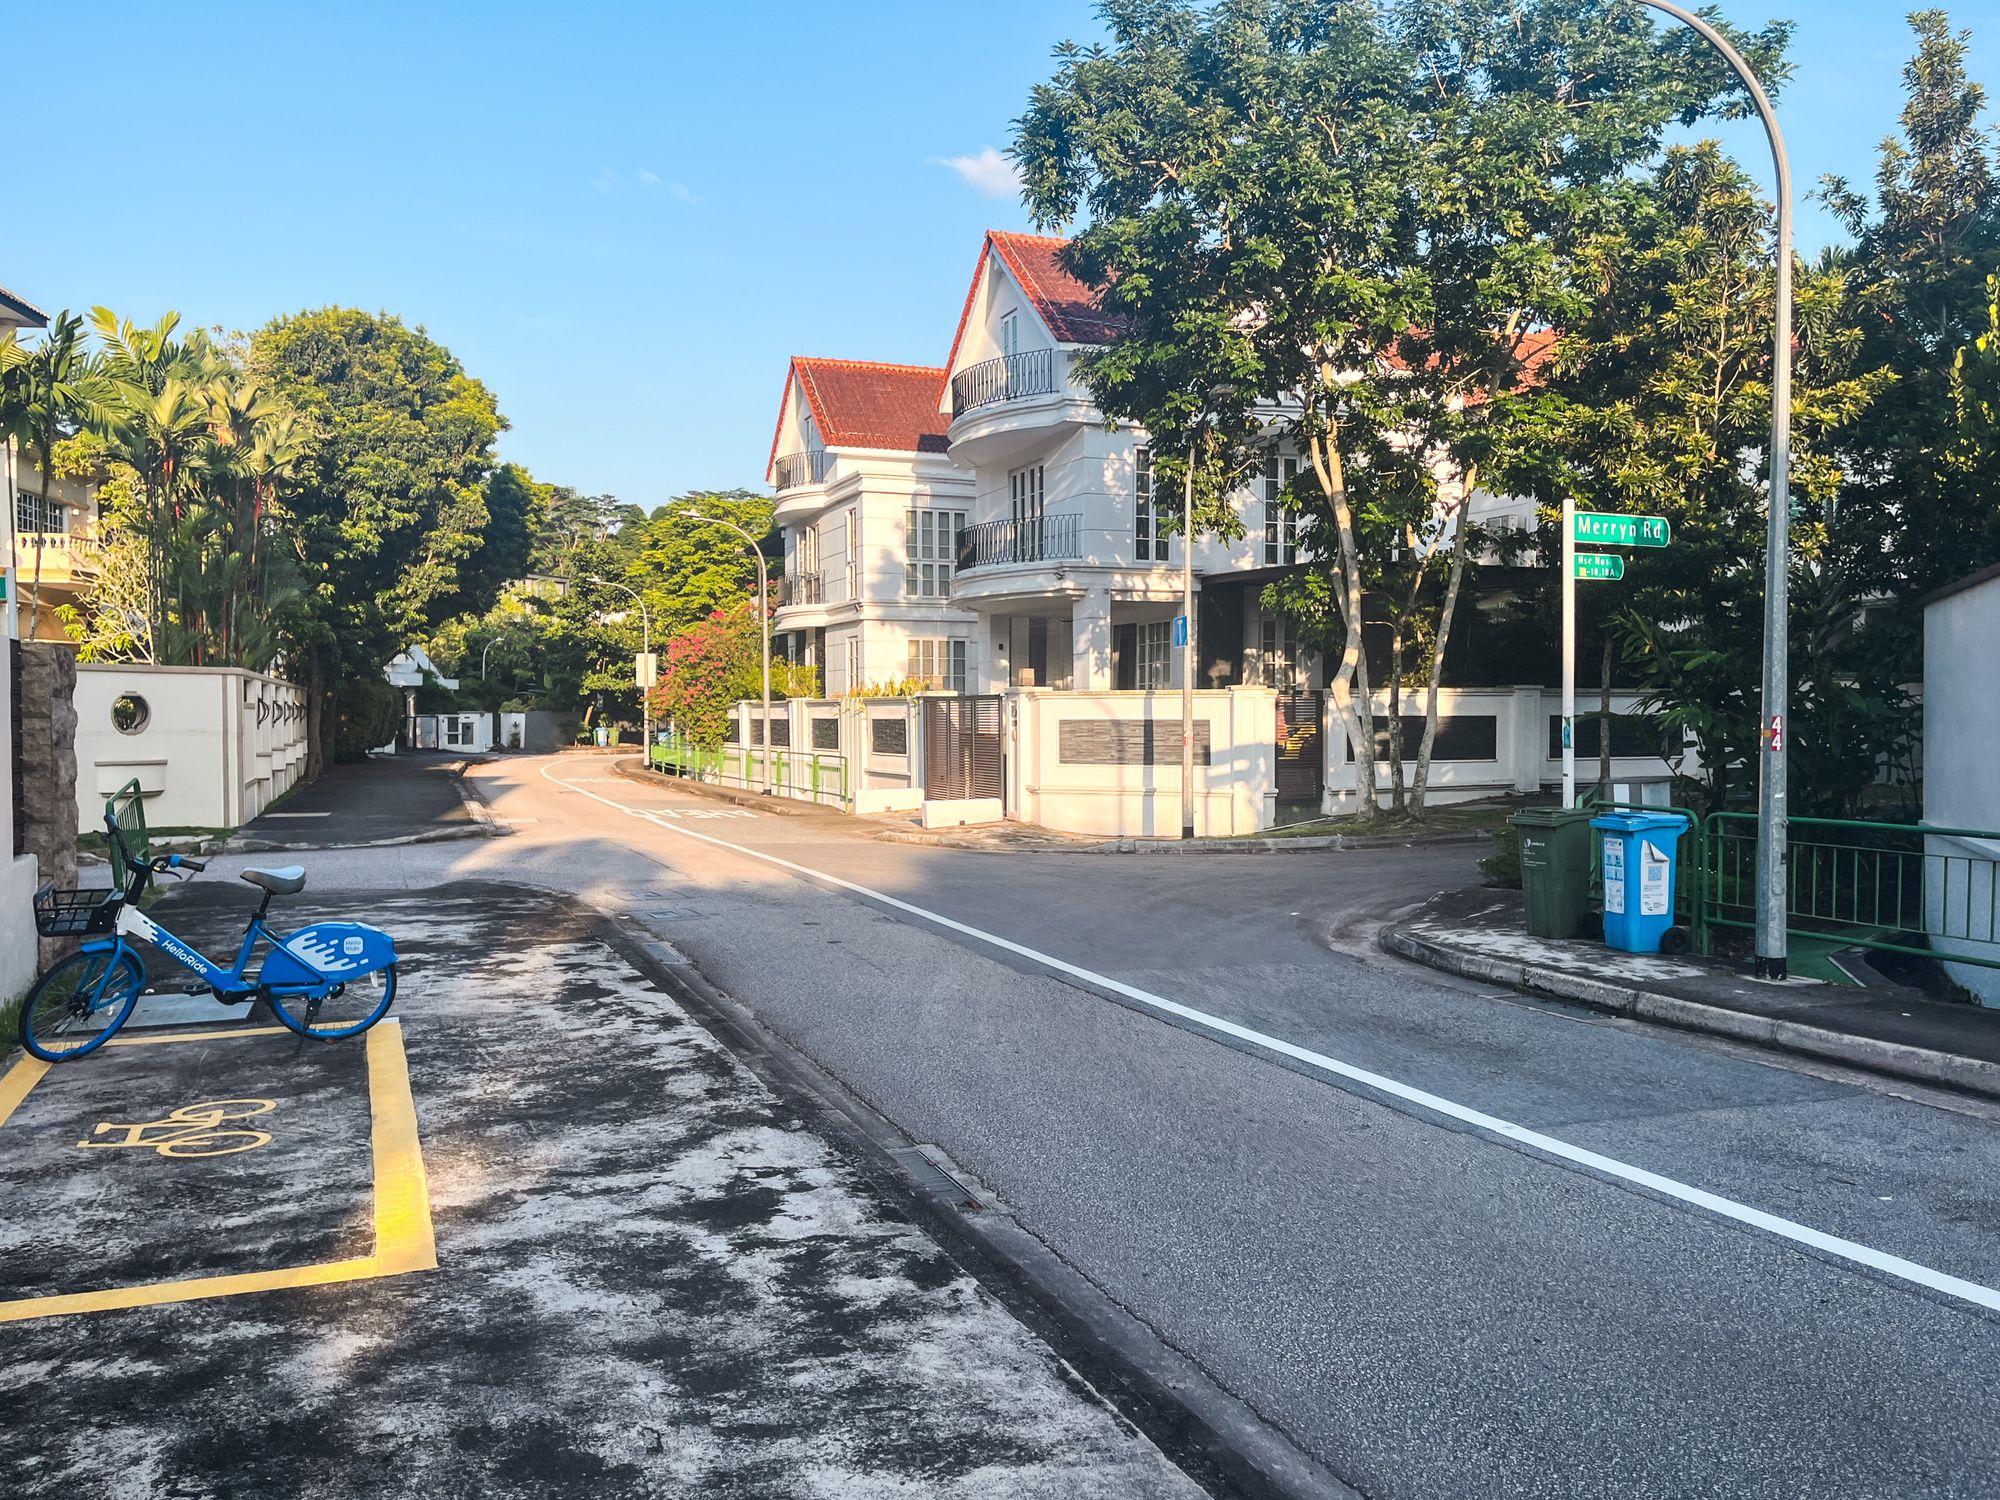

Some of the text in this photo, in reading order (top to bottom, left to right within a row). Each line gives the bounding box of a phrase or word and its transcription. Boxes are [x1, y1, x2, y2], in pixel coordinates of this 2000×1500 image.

[1577, 515, 1661, 541] Merryn Rd
[1578, 555, 1610, 566] Hse Nos
[161, 939, 208, 974] HelloRide
